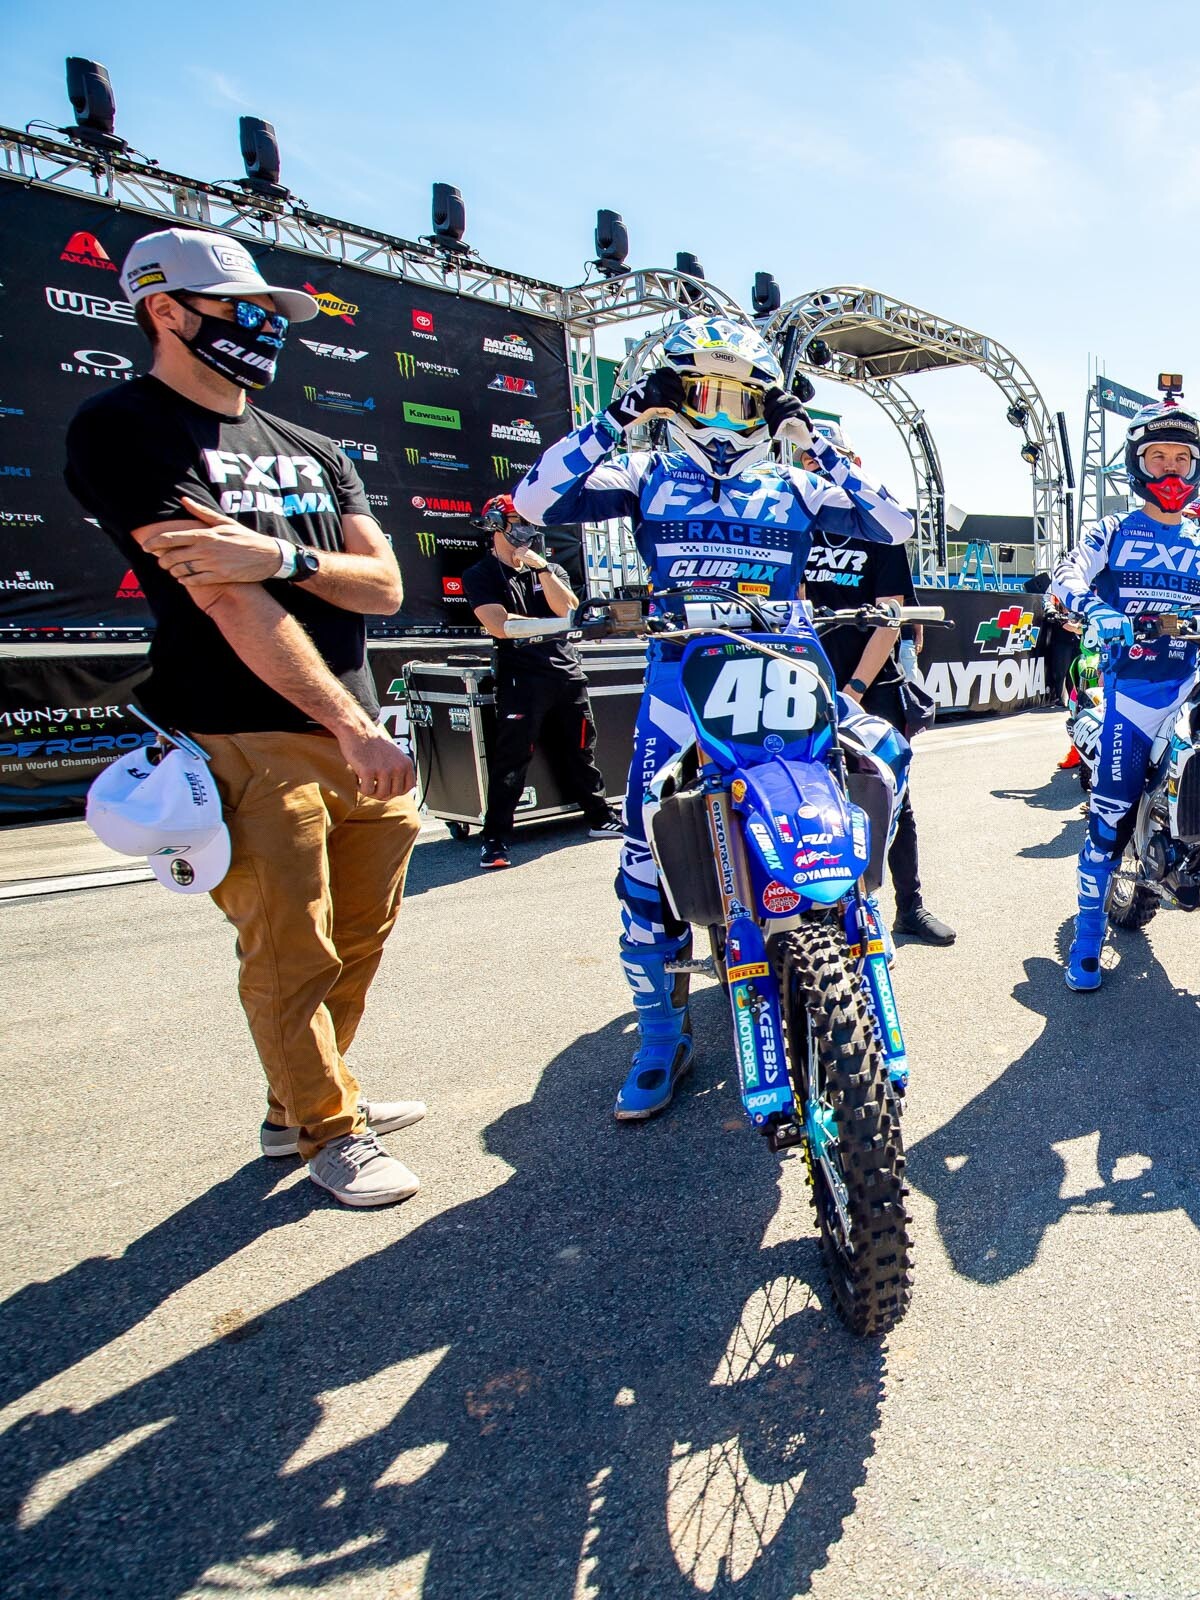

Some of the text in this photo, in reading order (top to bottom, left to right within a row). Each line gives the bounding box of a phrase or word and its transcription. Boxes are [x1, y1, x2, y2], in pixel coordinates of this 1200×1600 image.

[59, 252, 119, 272] AXALTA
[315, 297, 358, 314] NOCO
[411, 330, 438, 341] TOYOTA
[483, 345, 533, 361] SUPERCROSS
[484, 337, 533, 356] DAYTONA
[60, 363, 142, 381] OAKLE
[416, 360, 460, 375] MONSTER
[487, 373, 538, 398] AMA
[409, 408, 456, 423] Kawasaki
[490, 432, 541, 444] SUPERCROSS
[491, 423, 540, 439] DAYTONA
[332, 439, 377, 452] oPro
[202, 448, 324, 490] FXR
[672, 471, 706, 482] YAMAHA
[220, 490, 336, 518] CLUBMX
[425, 497, 473, 512] YAMAHA
[647, 480, 795, 524] FXR
[688, 521, 762, 545] RACE
[1130, 529, 1154, 538] YAMAHA
[436, 538, 478, 547] MONSTER
[703, 545, 751, 556] DIVISION
[808, 546, 868, 571] FXR
[669, 559, 780, 582] CLUBMX
[804, 569, 864, 587] CLUBMX
[1142, 573, 1189, 592] RACE
[1151, 591, 1182, 600] DIVISION
[529, 635, 544, 643] FLO
[566, 630, 583, 640] FLO
[917, 656, 1046, 708] AYTONA
[703, 657, 819, 736] 48
[14, 722, 106, 736] ENERGY
[1073, 716, 1099, 755] 464
[2, 752, 125, 773] FIM World Champions
[712, 800, 735, 896] enzoracing
[806, 866, 852, 880] YAMAHA
[872, 961, 898, 1029] MOTOREX
[738, 1010, 758, 1087] MOTOREX
